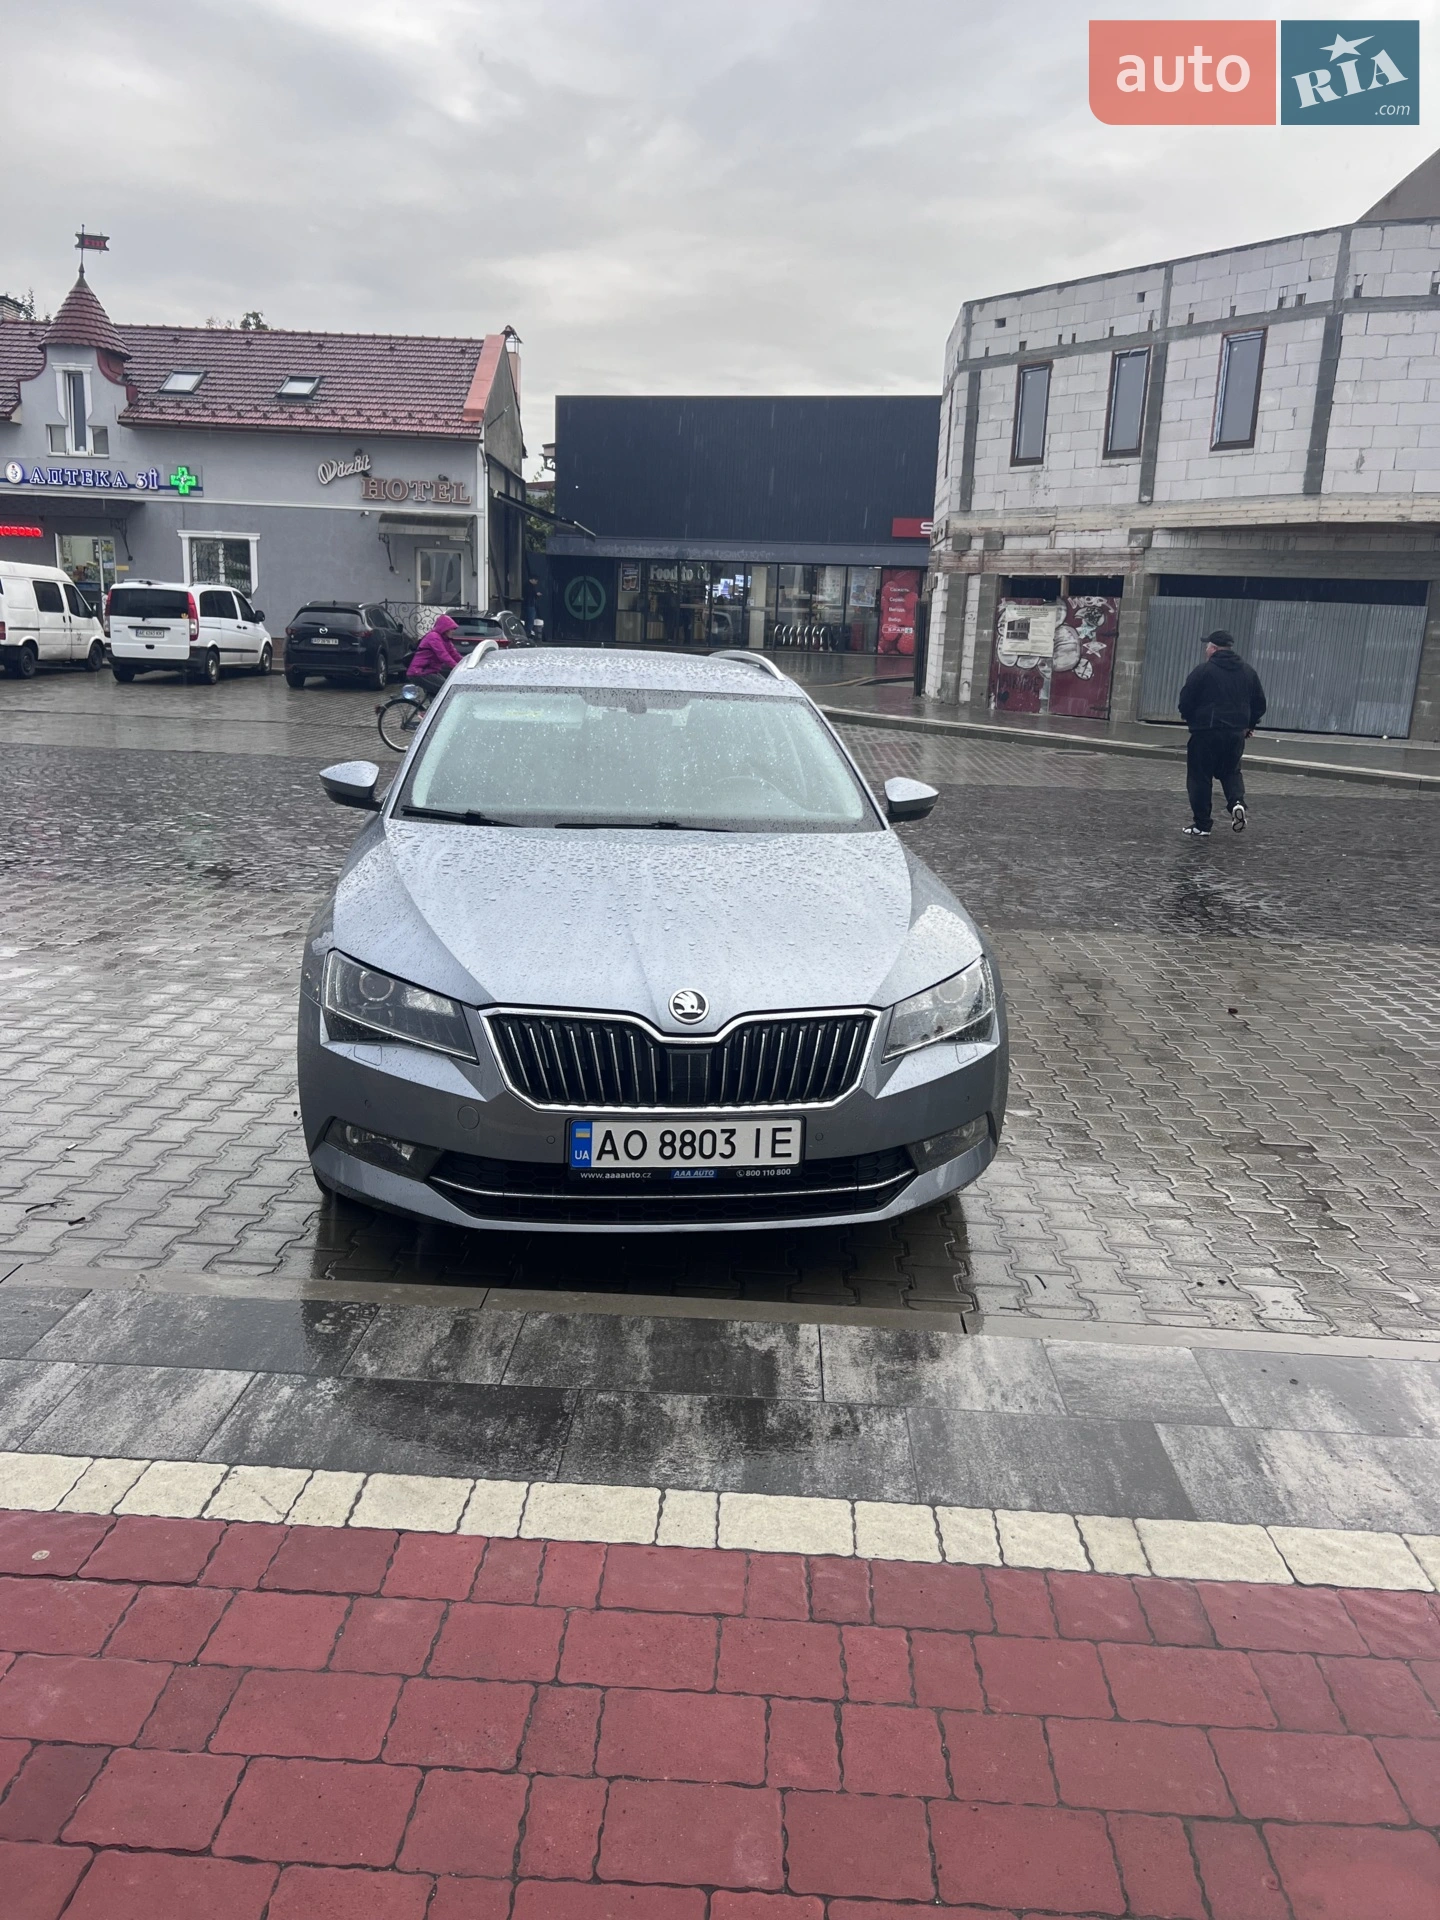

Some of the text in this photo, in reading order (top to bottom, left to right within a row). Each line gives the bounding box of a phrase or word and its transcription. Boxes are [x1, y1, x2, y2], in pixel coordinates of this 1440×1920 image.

[29, 466, 128, 488] АПТЕКА
[317, 454, 372, 485] Vizit
[361, 477, 472, 505] HOTEL
[649, 564, 678, 581] Food
[681, 566, 694, 582] to
[596, 1126, 793, 1161] AO 8803 IE
[574, 1150, 590, 1160] UA
[580, 1171, 652, 1179] www.aaaauto.cz
[693, 1169, 715, 1177] AUTO
[745, 1169, 761, 1177] 800
[776, 1168, 791, 1176] 800
